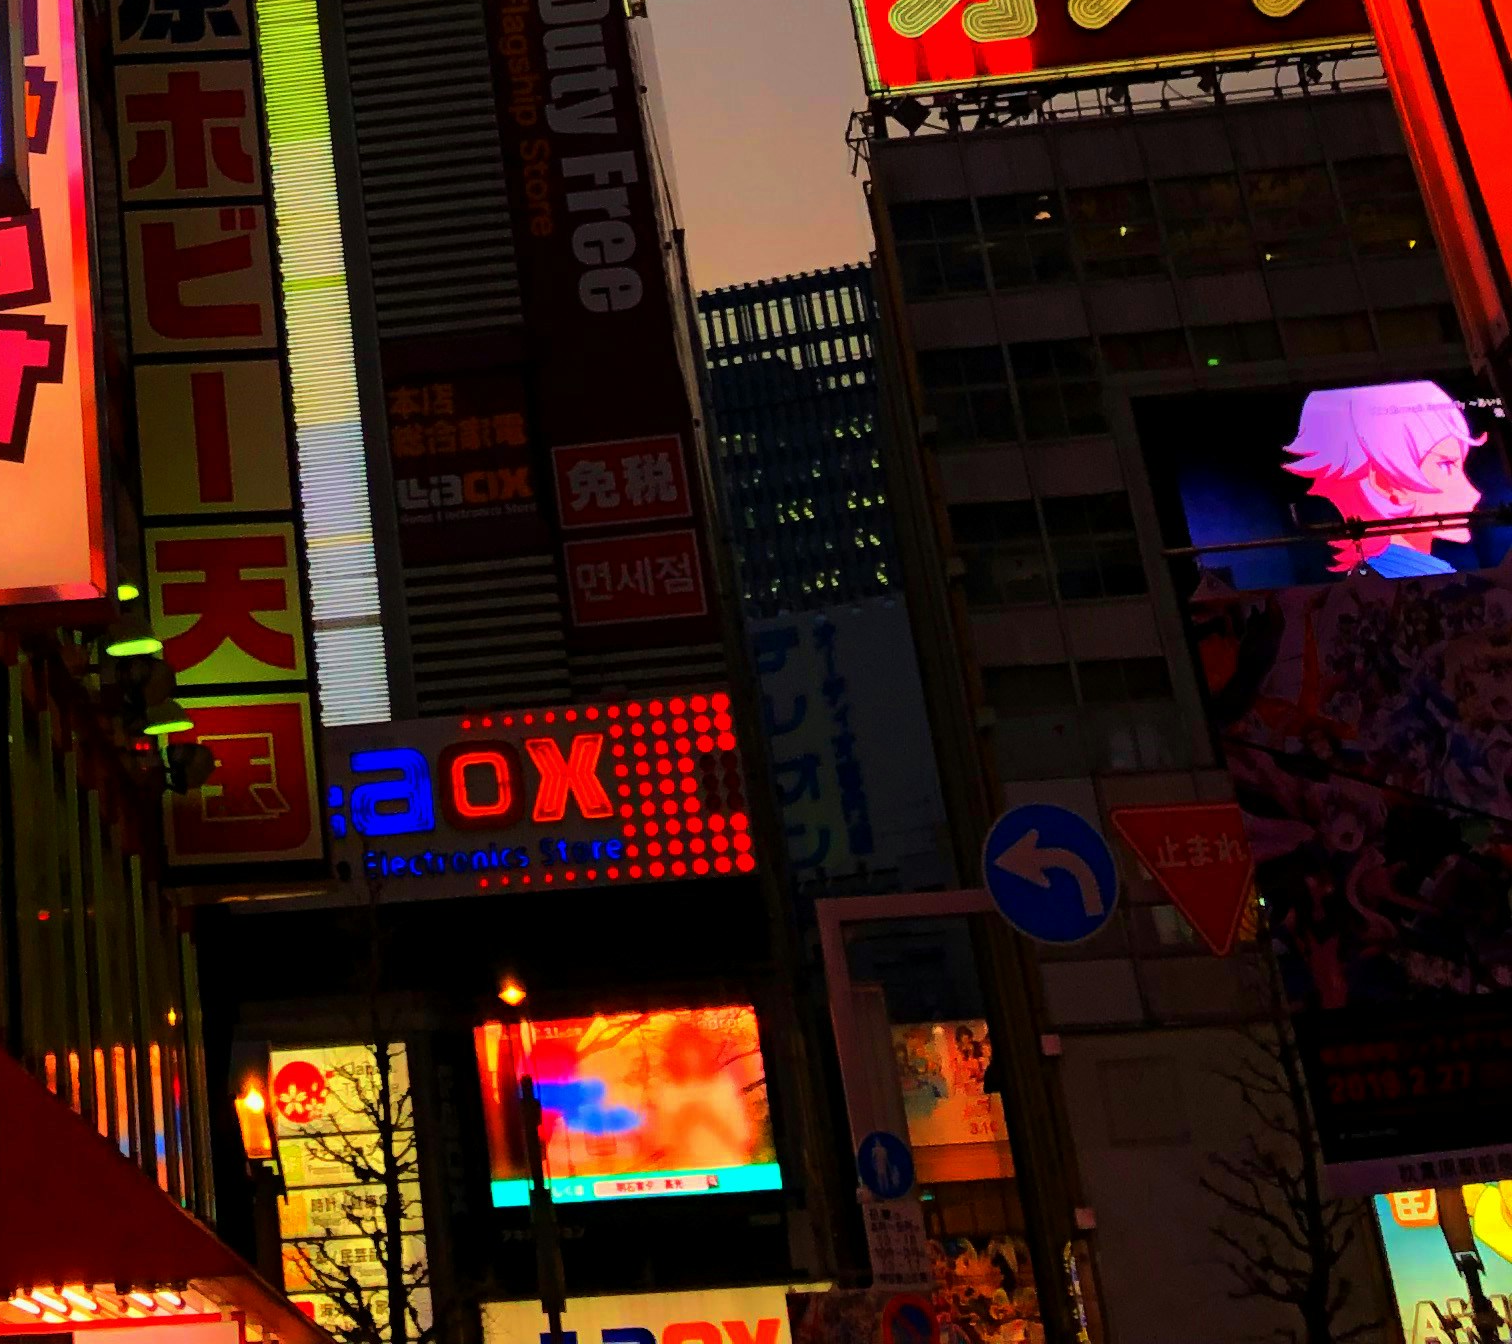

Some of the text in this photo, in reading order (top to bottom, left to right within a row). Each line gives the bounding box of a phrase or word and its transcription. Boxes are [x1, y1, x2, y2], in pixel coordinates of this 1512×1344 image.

[518, 137, 555, 238] Store
[561, 150, 646, 314] Free
[566, 452, 679, 512] 免税
[575, 551, 695, 602] 면세점
[363, 835, 623, 880] Electronics Store
[1155, 831, 1250, 870] 止まれ
